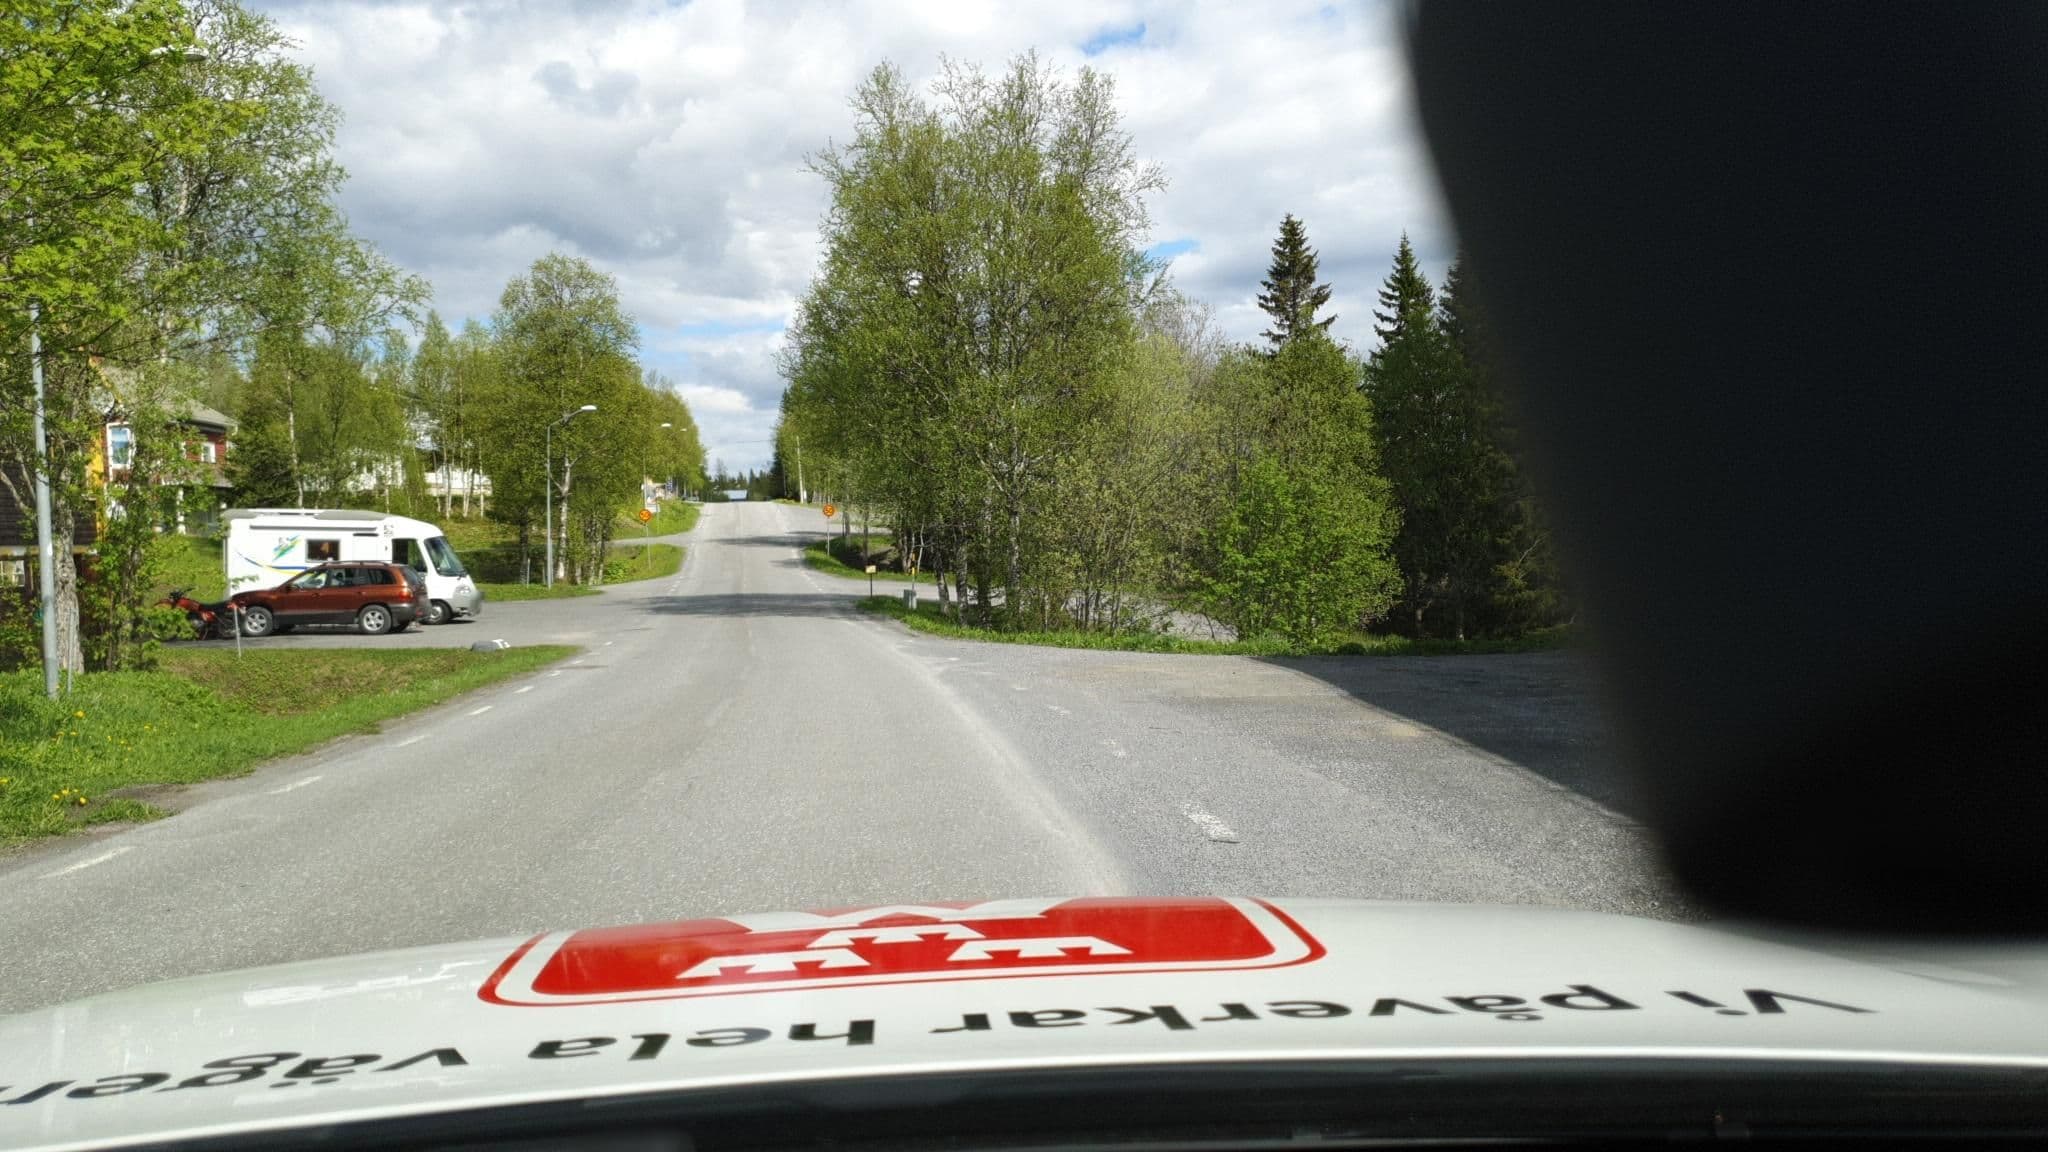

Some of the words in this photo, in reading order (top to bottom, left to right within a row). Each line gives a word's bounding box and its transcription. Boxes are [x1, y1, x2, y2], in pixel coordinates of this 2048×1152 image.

[932, 984, 1640, 1036] påverkar
[1664, 988, 1878, 1016] Vi
[527, 1019, 875, 1060] hela
